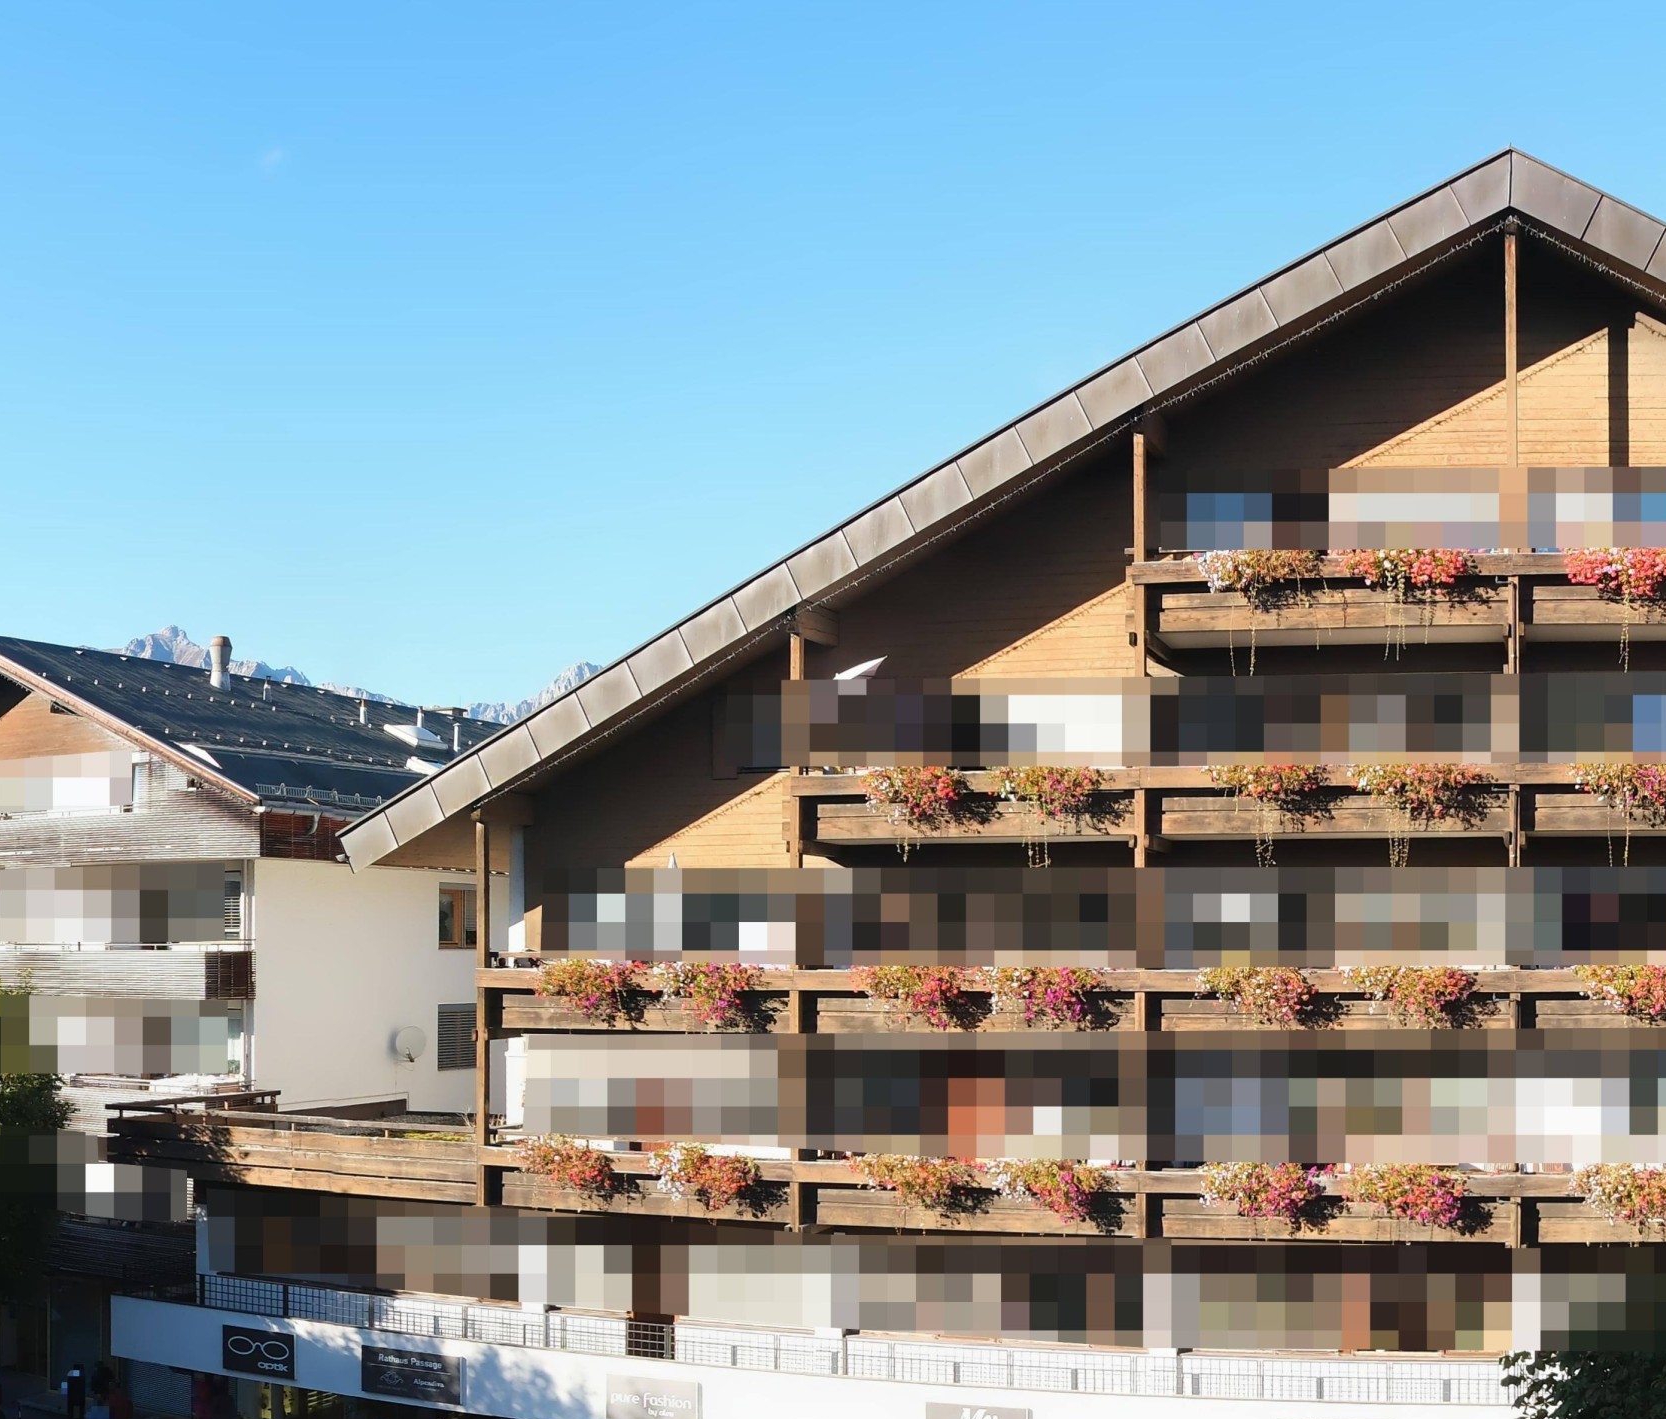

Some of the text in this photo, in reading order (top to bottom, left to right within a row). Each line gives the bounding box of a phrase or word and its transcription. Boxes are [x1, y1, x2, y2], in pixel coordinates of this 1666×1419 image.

[257, 1361, 289, 1373] optik
[378, 1353, 442, 1370] Rathaus Passage
[610, 1392, 692, 1409] pure fashion
[647, 1407, 658, 1417] by
